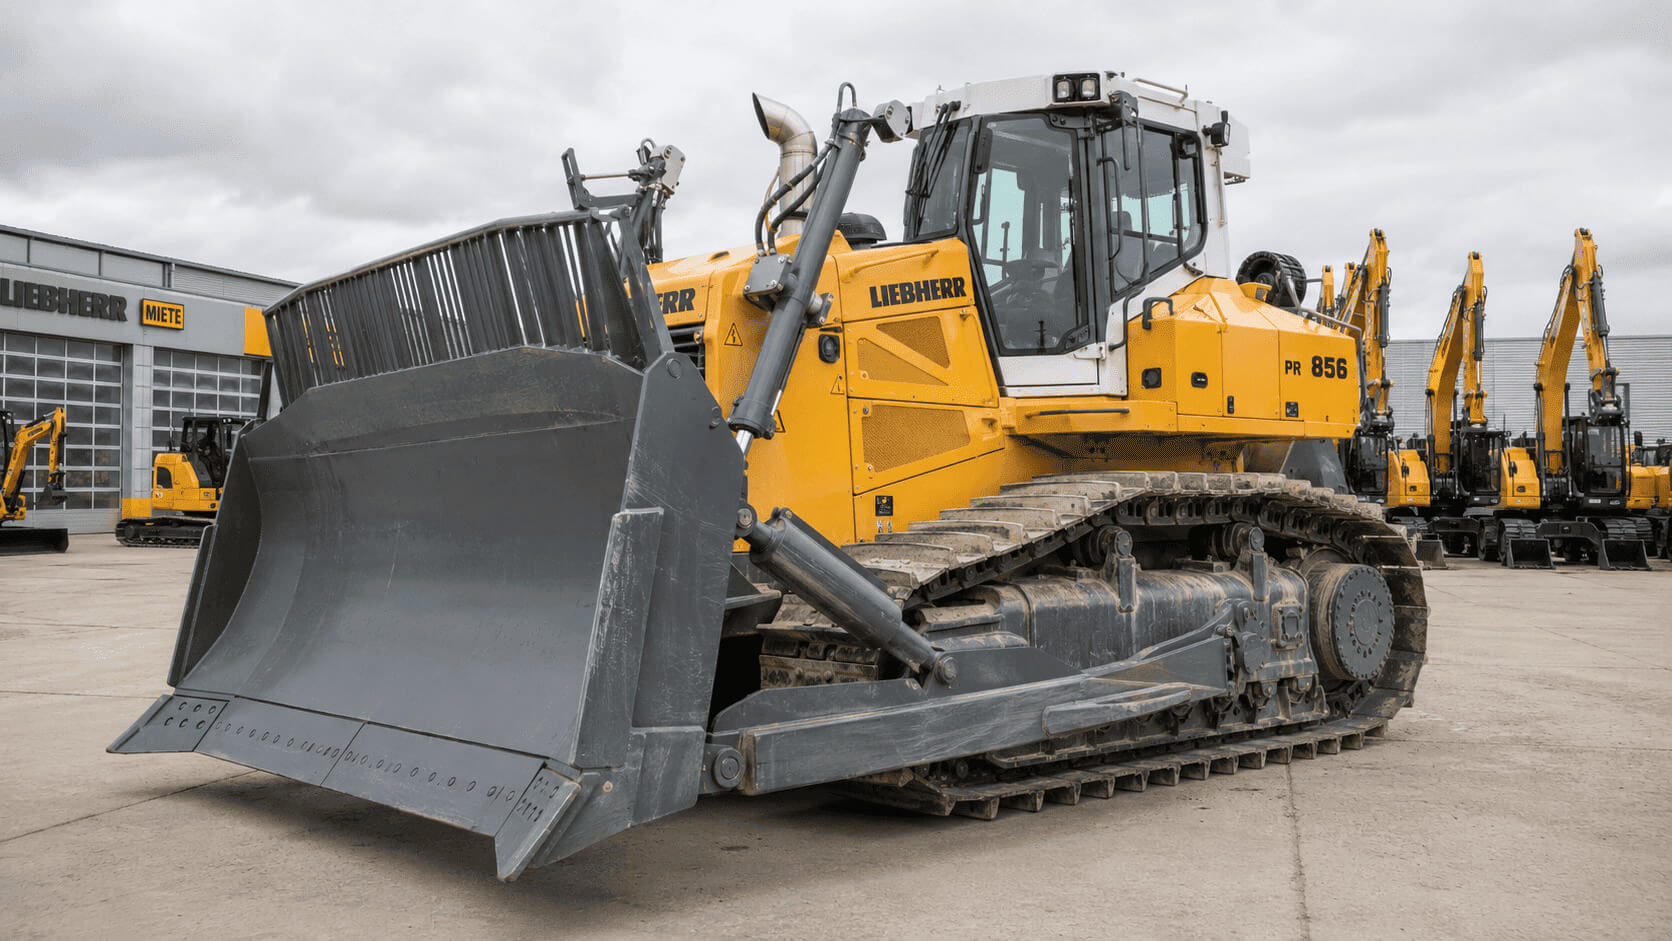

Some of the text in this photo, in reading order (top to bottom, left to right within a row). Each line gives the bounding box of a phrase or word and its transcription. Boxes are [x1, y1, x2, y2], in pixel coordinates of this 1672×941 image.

[0, 278, 128, 321] LIEBHERR
[869, 277, 967, 308] LIEBHERR
[145, 304, 182, 325] MIETE
[1285, 355, 1347, 379] PR 856
